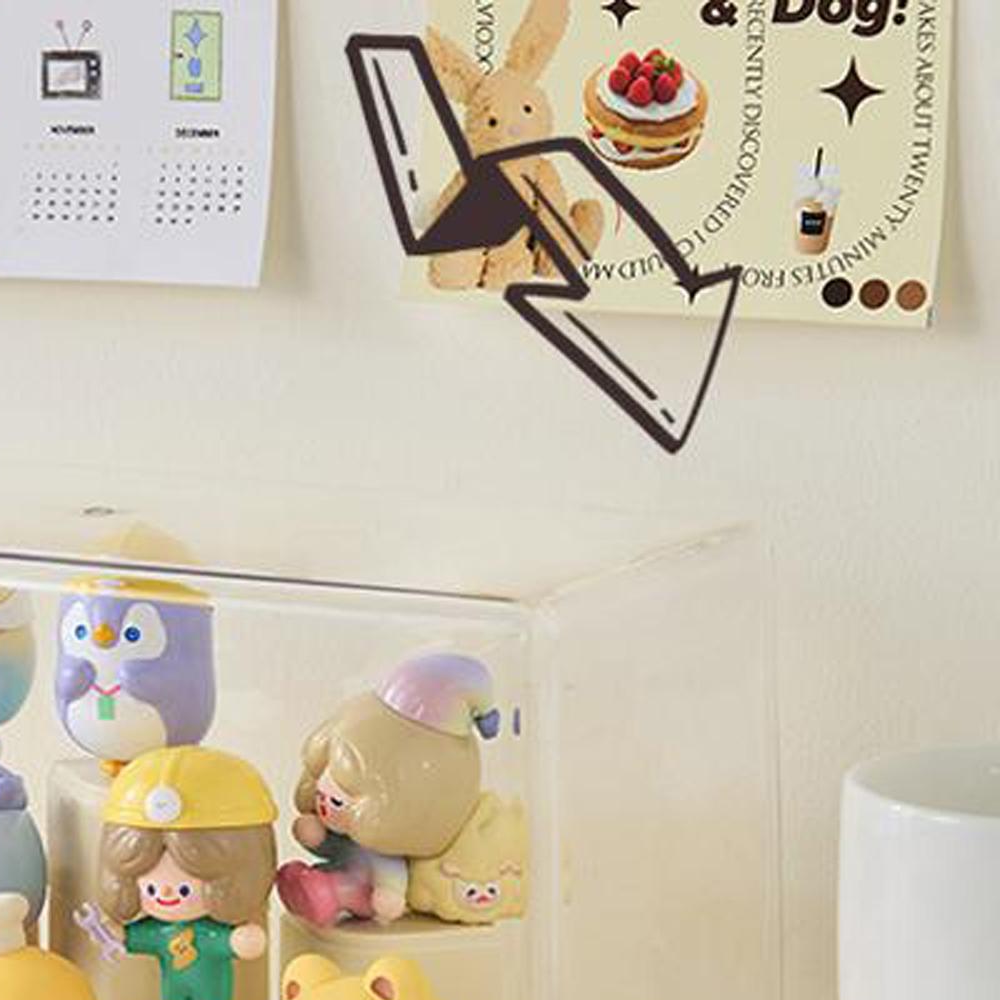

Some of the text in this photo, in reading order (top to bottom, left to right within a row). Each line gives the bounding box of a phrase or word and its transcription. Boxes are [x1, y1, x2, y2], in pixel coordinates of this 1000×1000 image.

[700, 0, 738, 27] &
[914, 56, 935, 132] ABOUT
[702, 104, 763, 234] DISCOVERED
[884, 137, 933, 231] TWENTY
[617, 237, 696, 280] CULD
[741, 266, 785, 288] FRO
[791, 226, 888, 284] MINUTES
